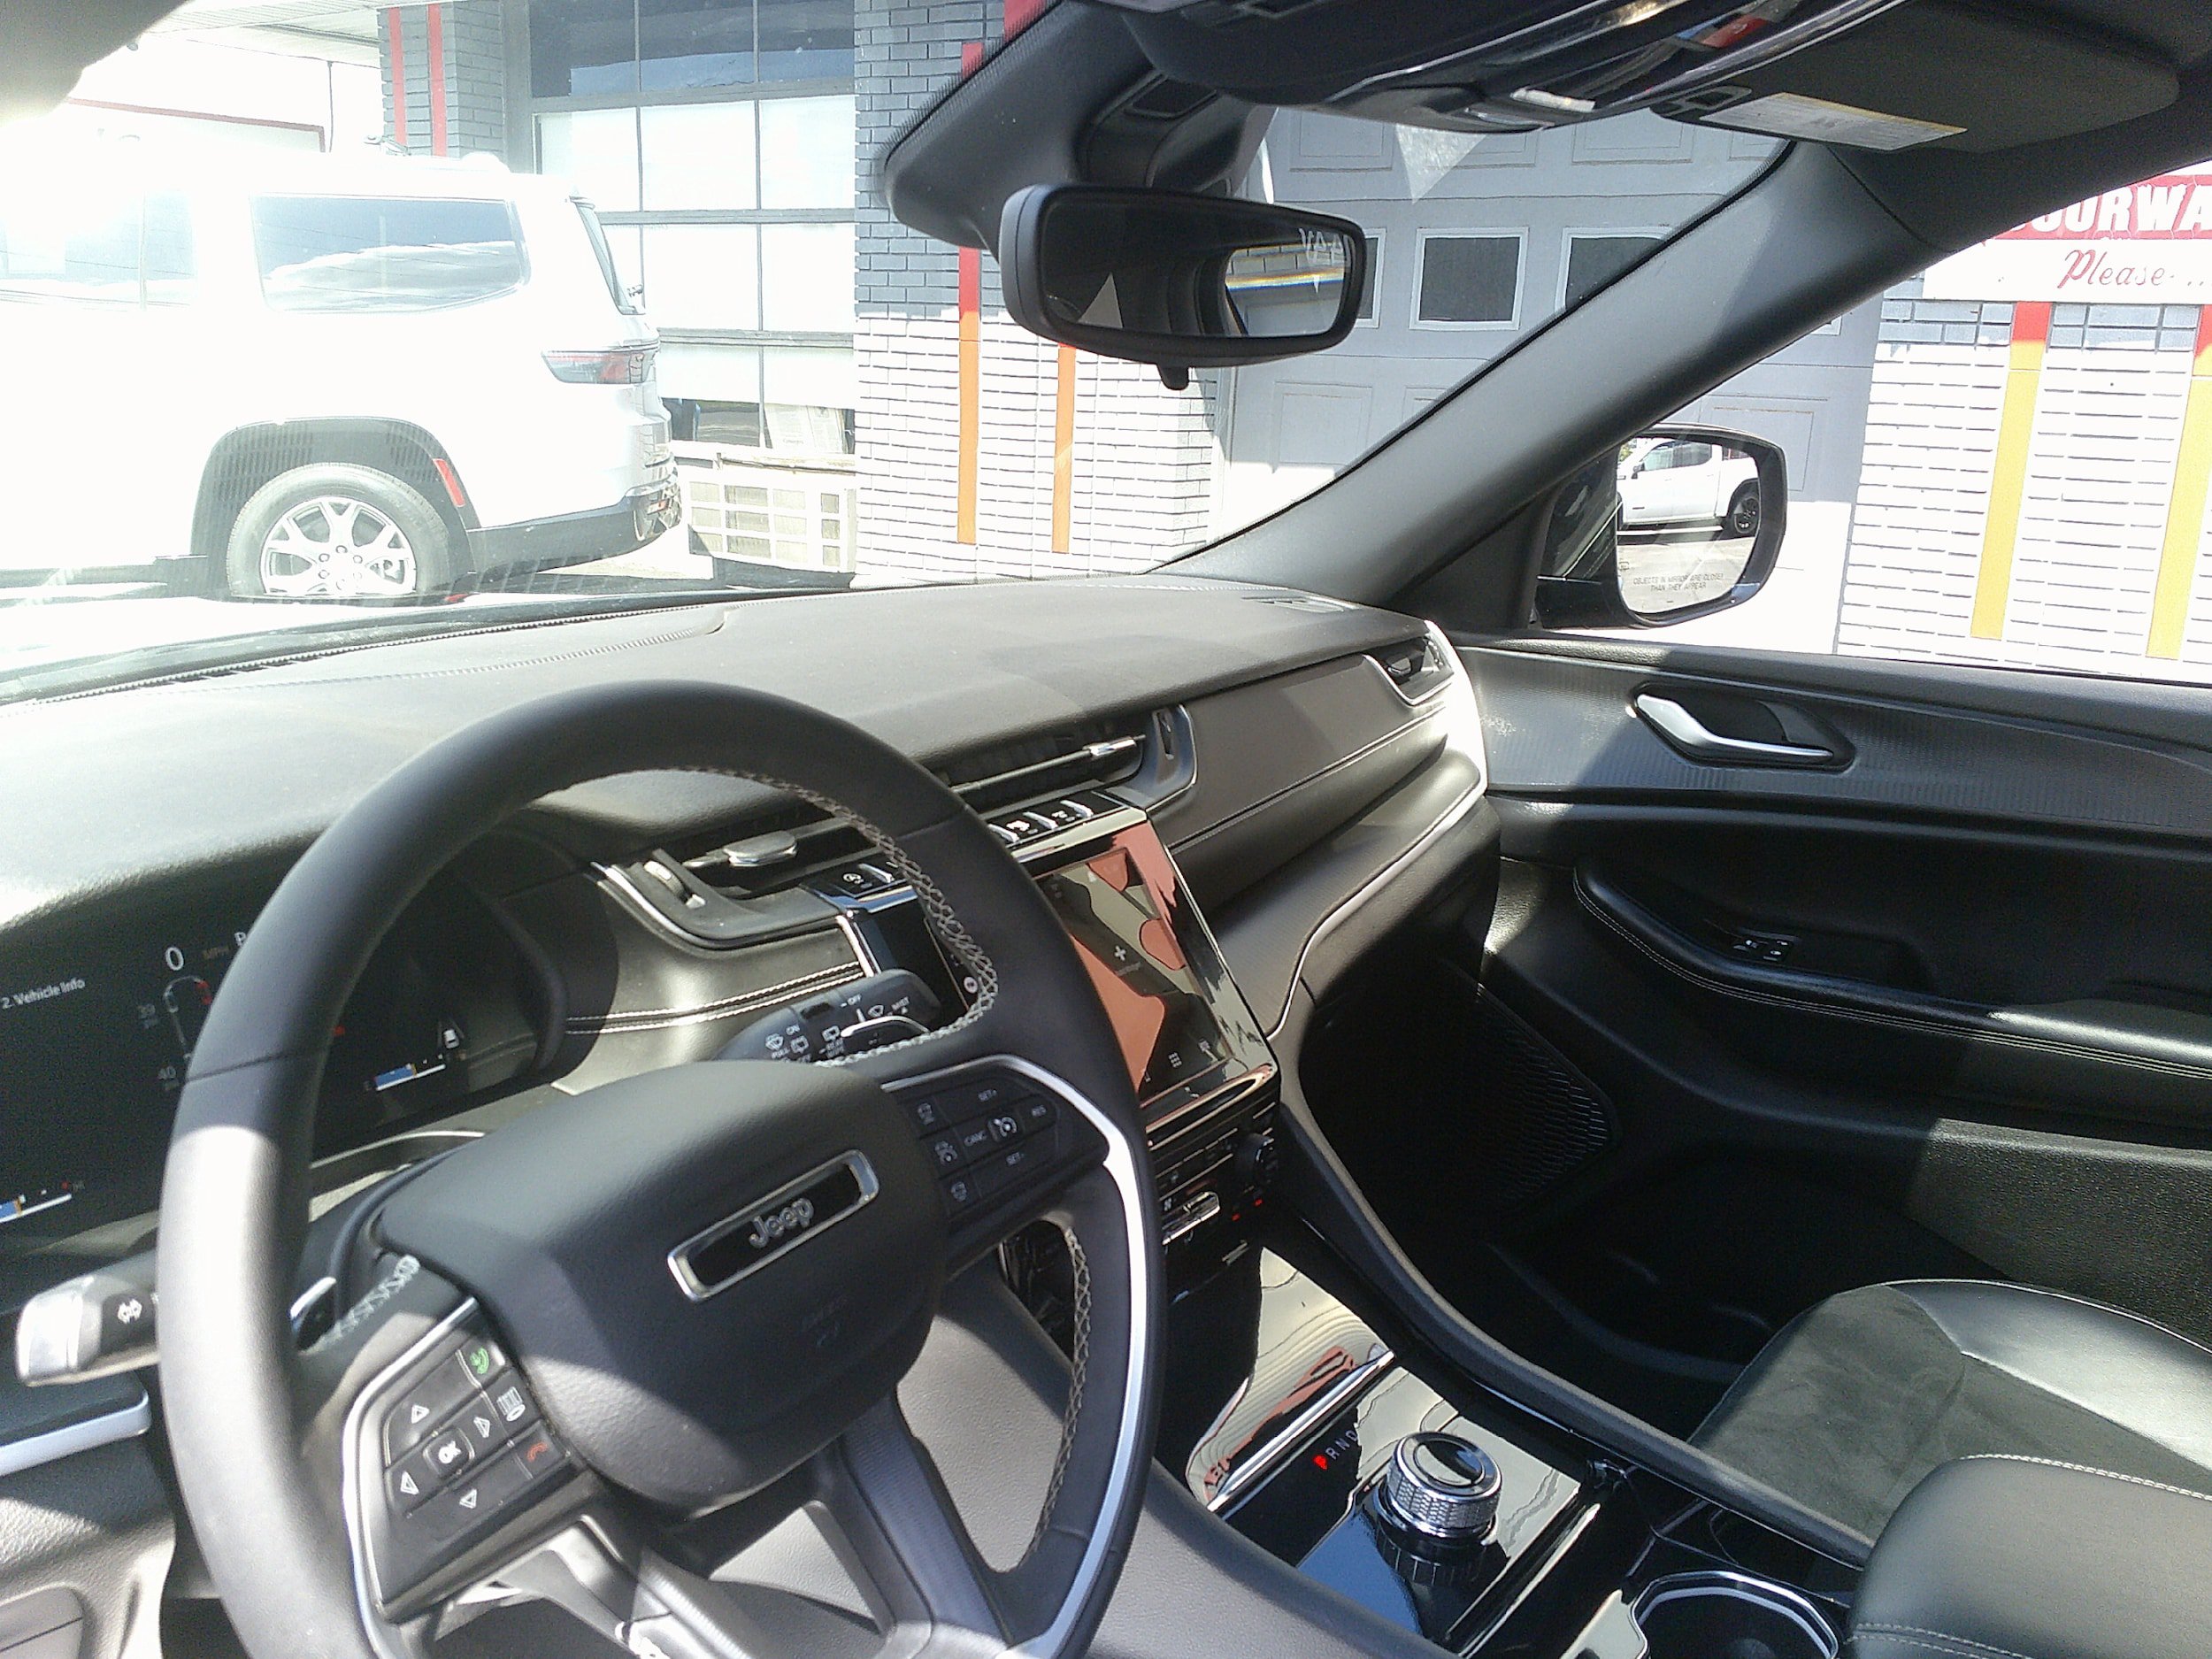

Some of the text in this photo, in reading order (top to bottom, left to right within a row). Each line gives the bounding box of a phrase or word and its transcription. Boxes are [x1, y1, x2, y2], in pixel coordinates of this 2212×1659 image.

[13, 986, 61, 1006] Vehicle
[59, 978, 86, 994] Info
[749, 1198, 814, 1248] Jeep
[1325, 1447, 1340, 1460] R
[1335, 1437, 1350, 1450] N
